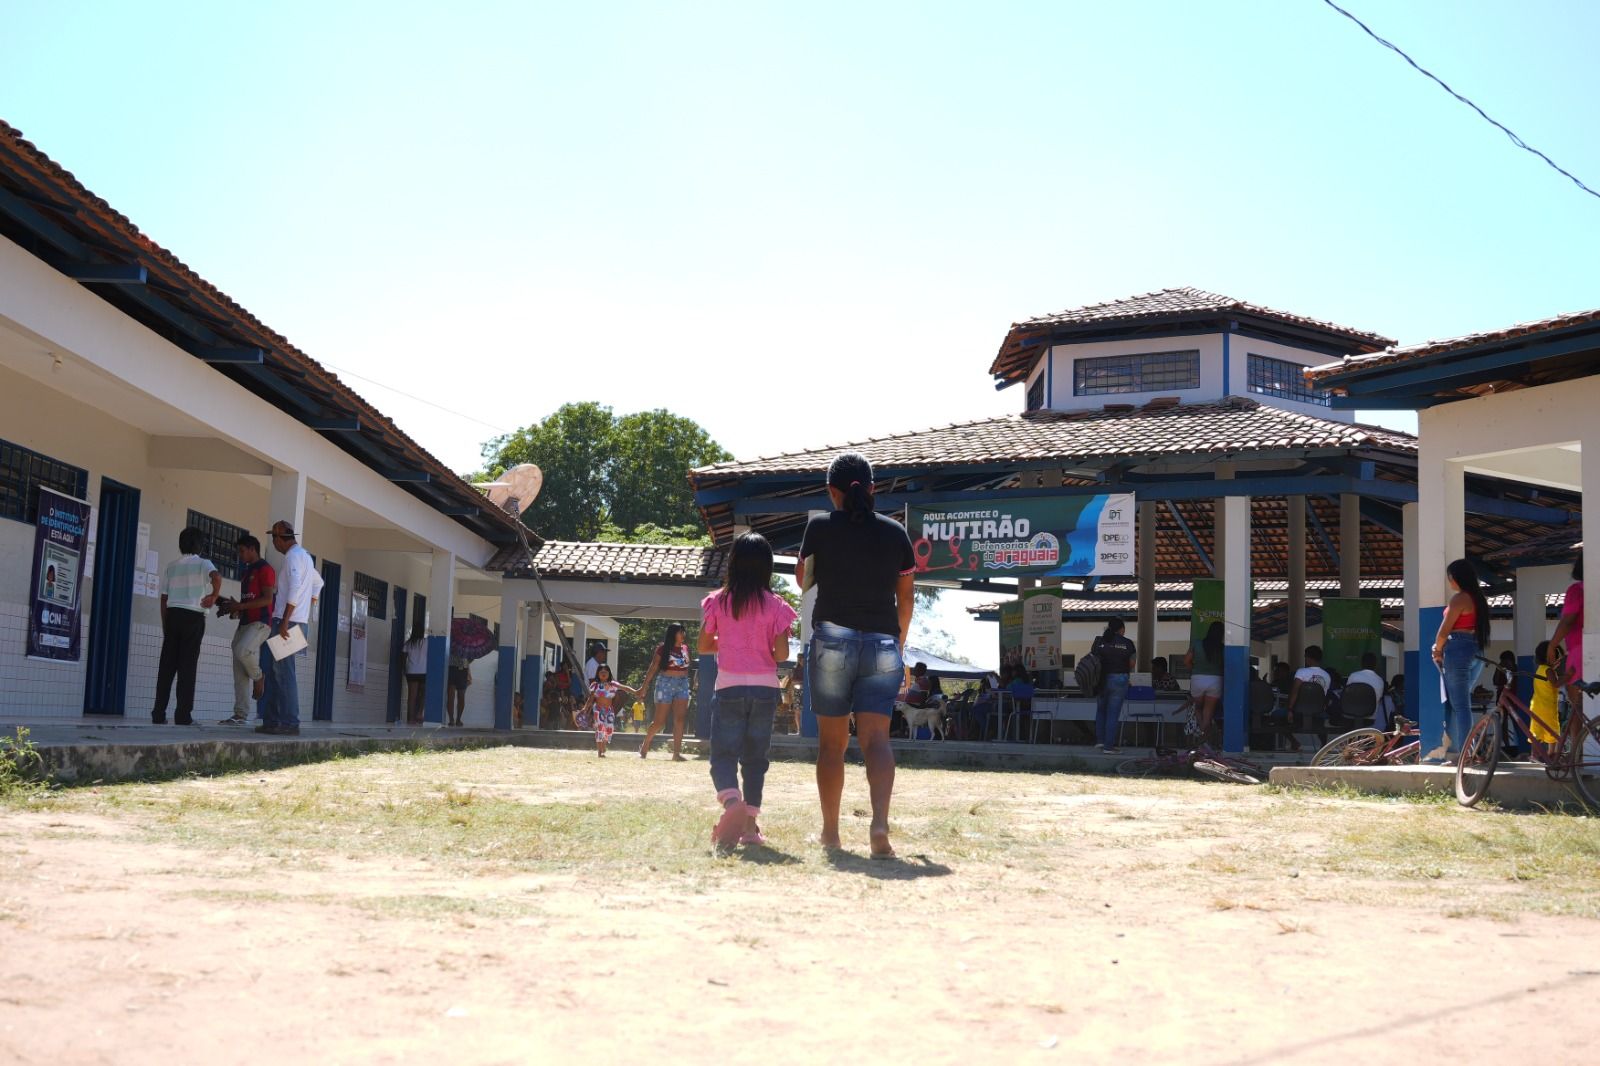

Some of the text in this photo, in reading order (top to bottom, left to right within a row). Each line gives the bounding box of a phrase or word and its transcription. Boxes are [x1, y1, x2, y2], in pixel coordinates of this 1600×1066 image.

[49, 507, 54, 516] O
[923, 510, 999, 521] AQUI ACONTECE O
[922, 514, 1030, 541] MUTIRÃO
[972, 539, 1028, 552] Defensorias
[983, 548, 1058, 566] do araguaia
[49, 612, 62, 624] CIN
